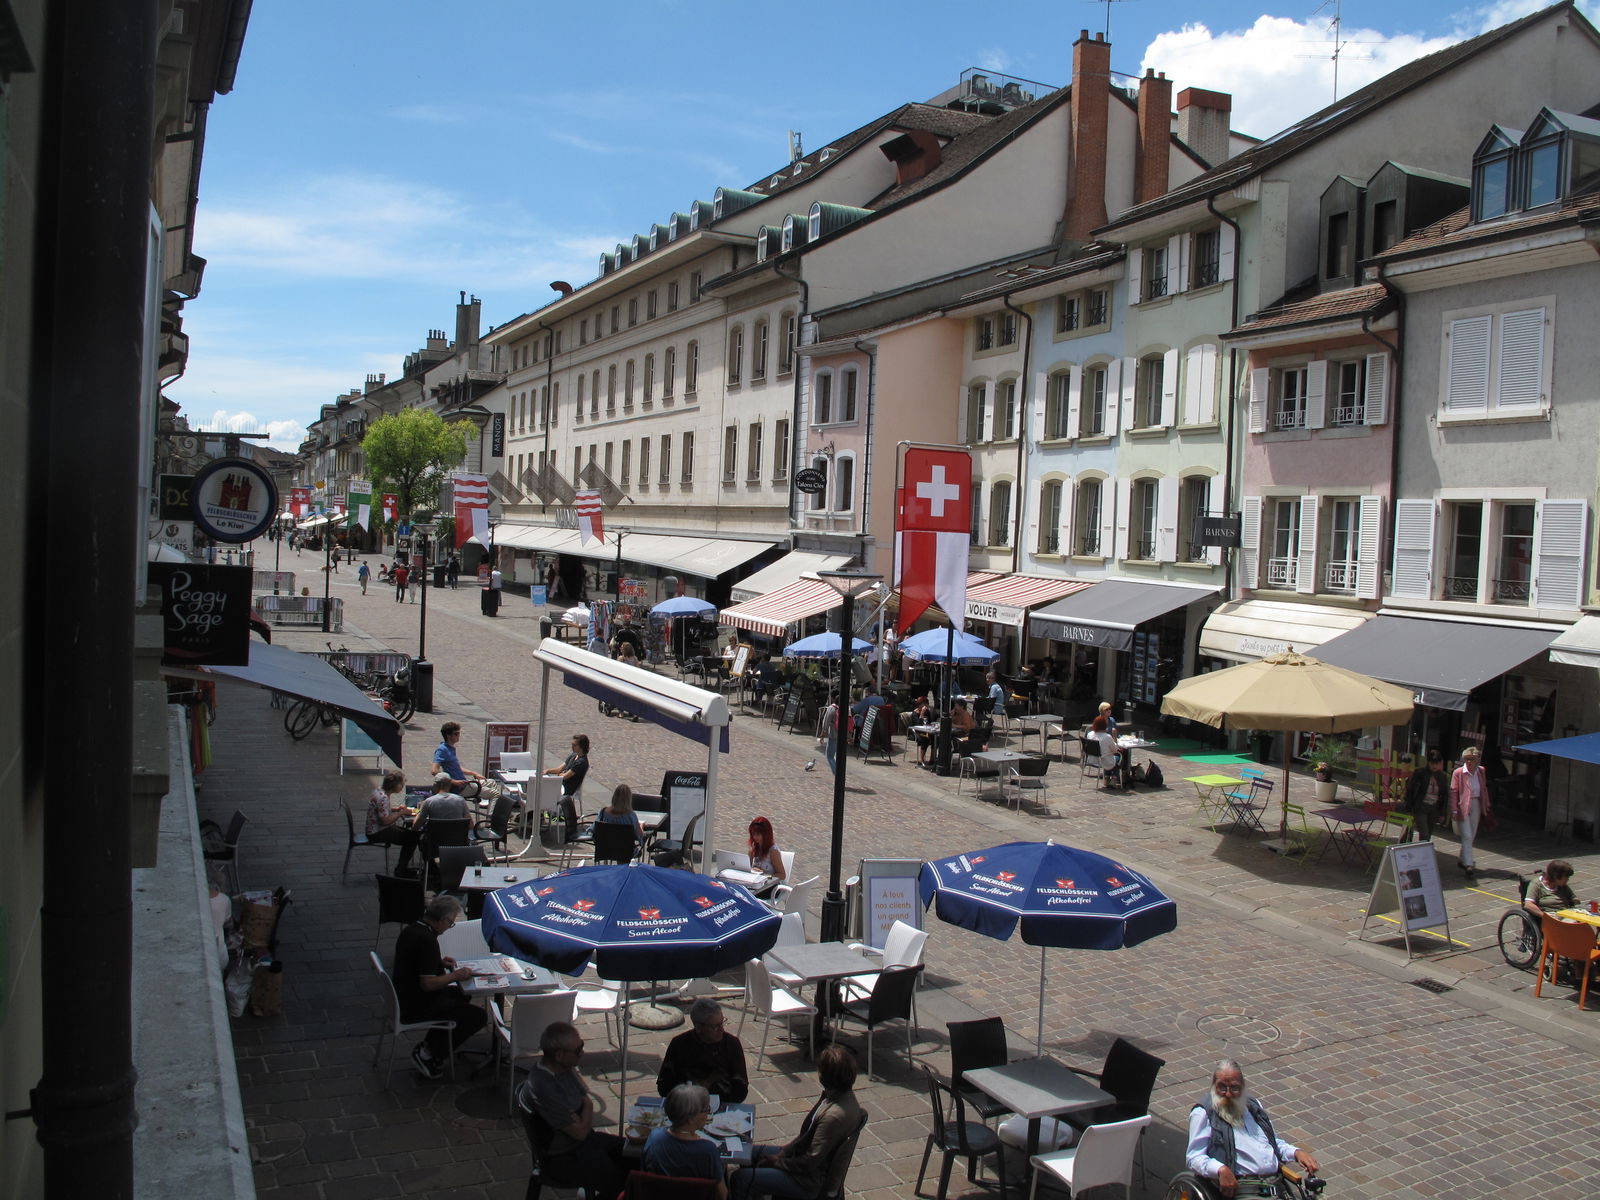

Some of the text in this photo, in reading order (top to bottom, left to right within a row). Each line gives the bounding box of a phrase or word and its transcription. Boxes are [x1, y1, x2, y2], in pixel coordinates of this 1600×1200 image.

[494, 417, 502, 452] MANOR
[216, 519, 245, 530] Le Kiwi
[1204, 527, 1236, 537] BARNES
[169, 570, 227, 613] Peggy
[968, 603, 998, 619] VOLVER
[167, 603, 224, 635] Sage
[1063, 625, 1095, 642] BARNES
[1036, 886, 1100, 897] FELDSCHLÖSSCHEN
[1047, 895, 1093, 906] Alkoholfrei
[616, 916, 690, 927] FELDSCHLÖSSCHEN
[628, 924, 682, 938] Sans Alcool
